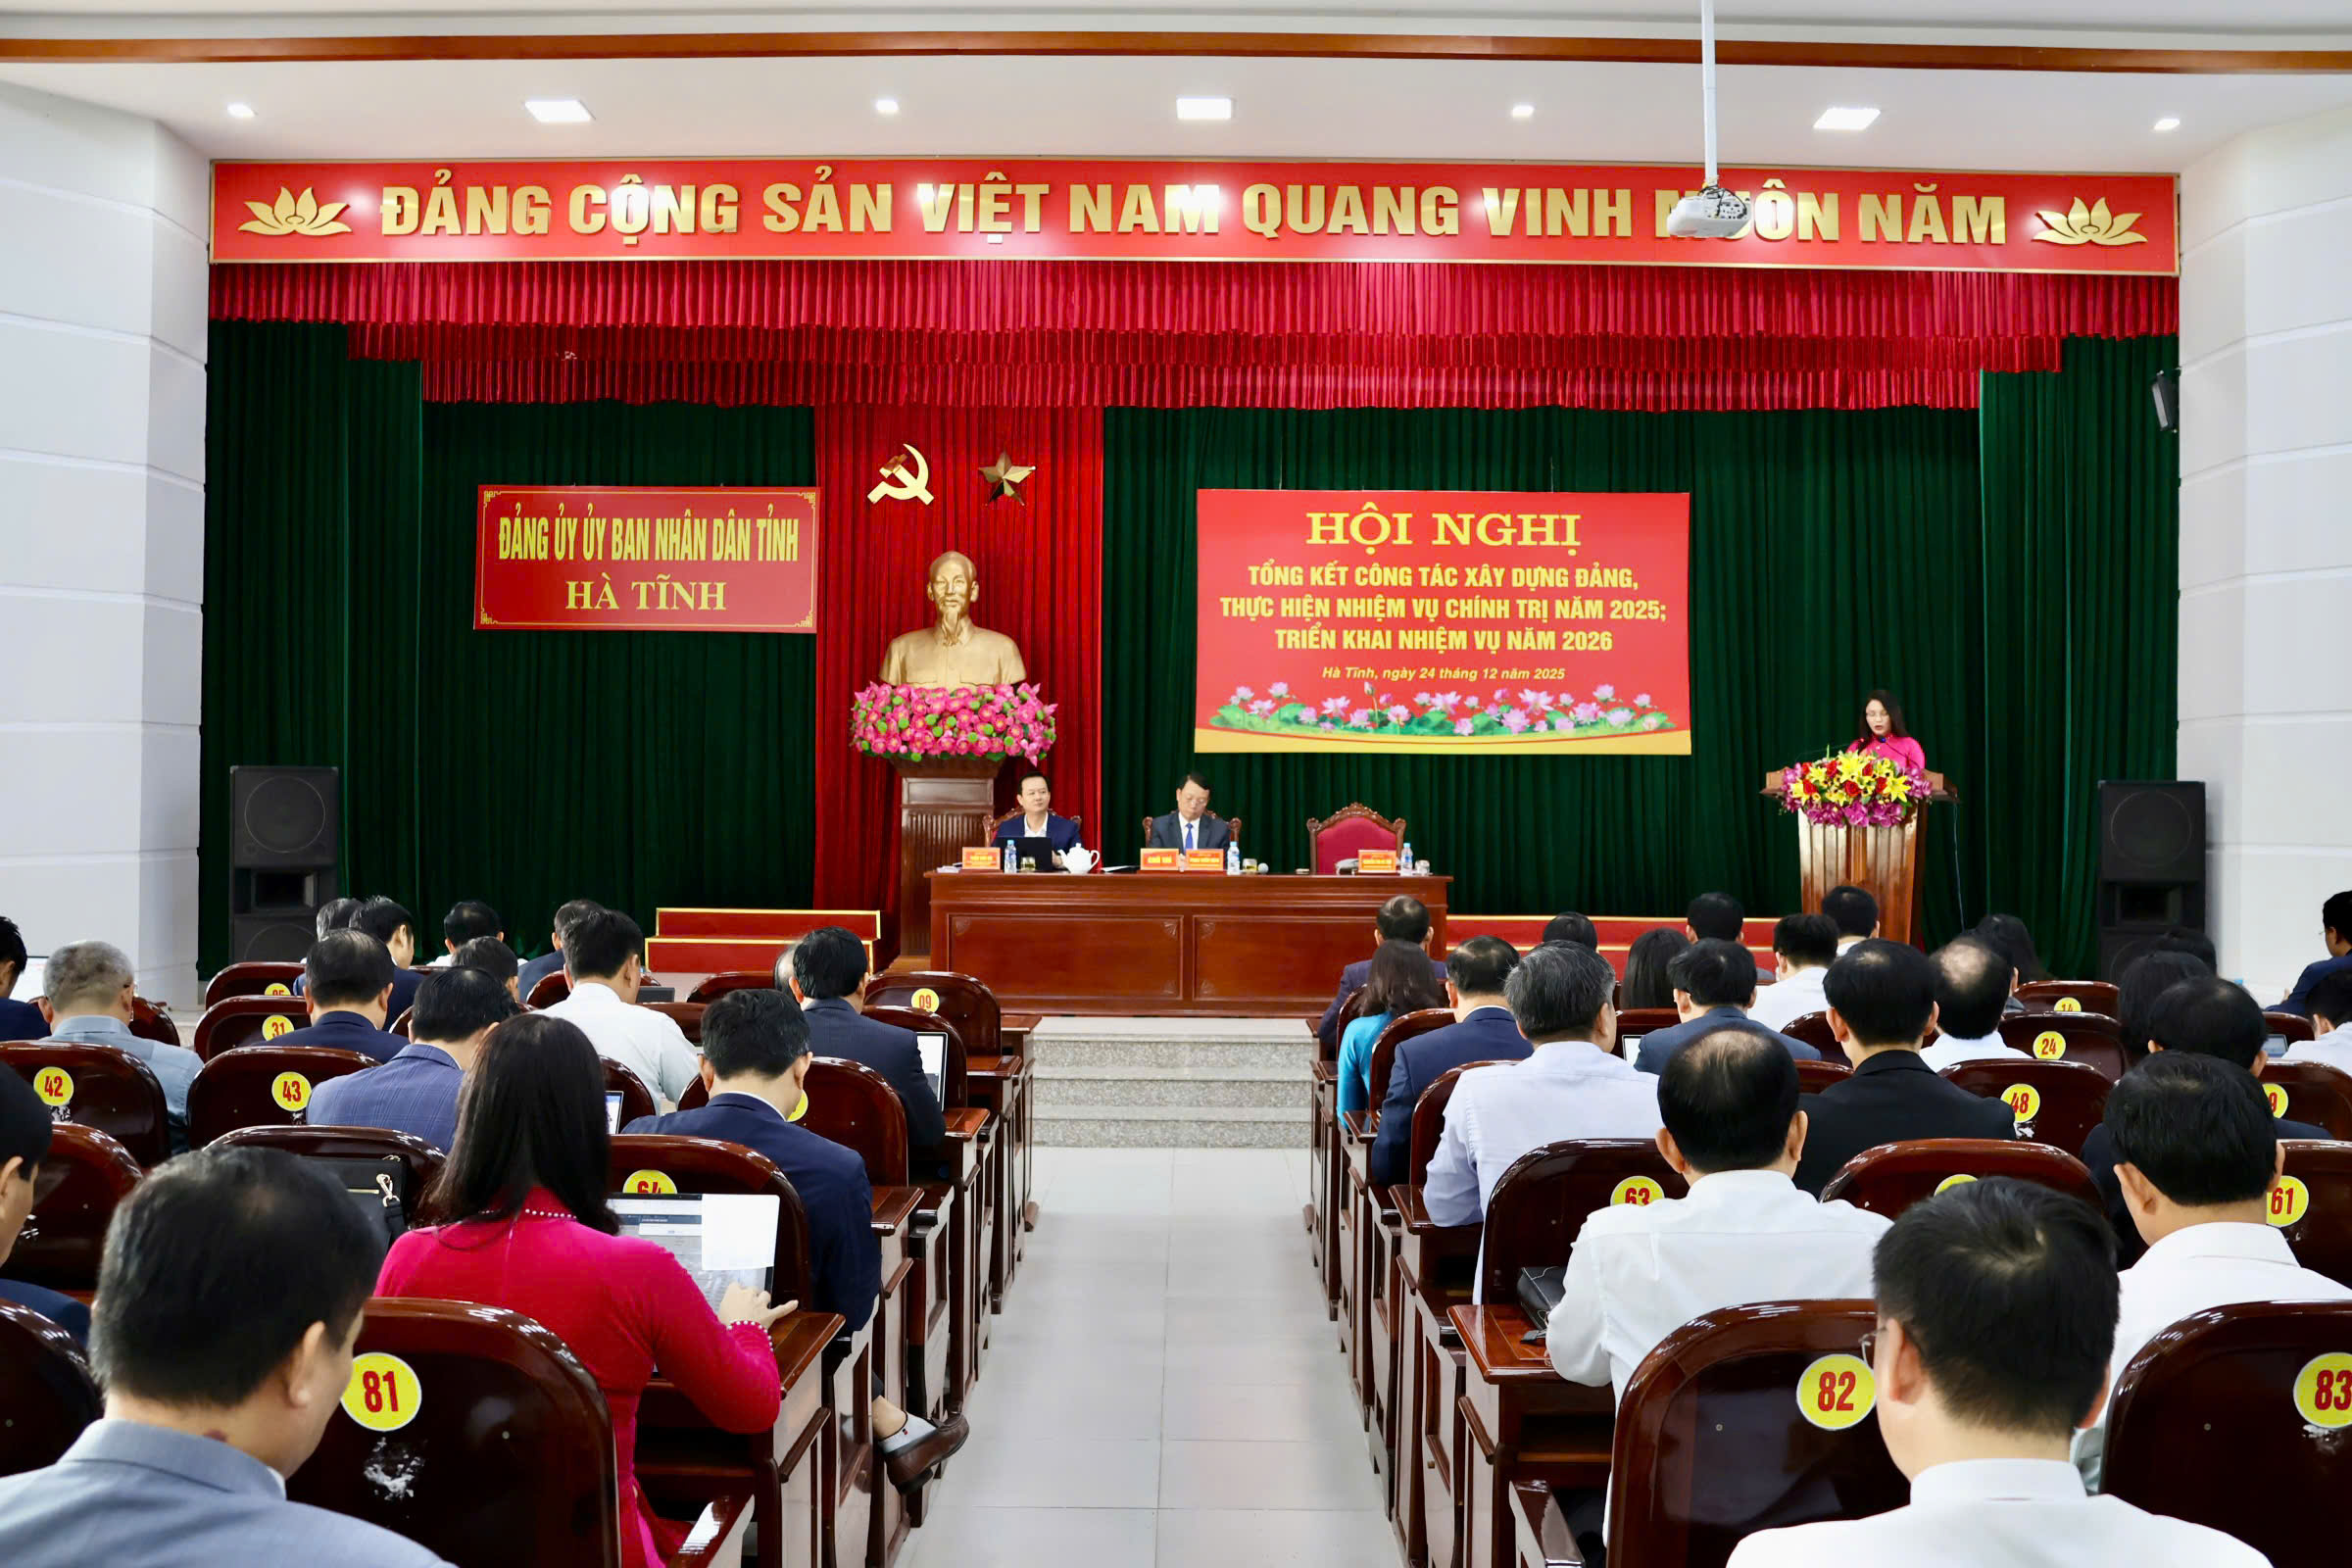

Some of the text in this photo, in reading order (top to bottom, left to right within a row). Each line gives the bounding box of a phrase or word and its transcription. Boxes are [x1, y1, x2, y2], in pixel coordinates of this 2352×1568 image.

[379, 169, 552, 235] ĐẢNG
[568, 173, 738, 245] CỘNG
[762, 166, 893, 233] SẢN
[916, 172, 1050, 244] VIỆT
[1069, 183, 1220, 235] NAM
[1243, 183, 1459, 239] QUANG
[1482, 187, 1633, 238] VINH
[1860, 182, 2006, 245] NĂM
[499, 502, 800, 562] ĐẢNG ỦY ỦY BAN NHÂN DÂN TỈNH
[1306, 501, 1582, 556] HỘI NGHỊ
[1249, 559, 1639, 591] TỔNG KẾT CÔNG TÁC XÂY DỰNG ĐẢNG,
[565, 572, 727, 612] HÀ TĨNH
[1220, 594, 1666, 623] THỰC HIỆN NHIỆM VỤ CHÍNH TRỊ NĂM 2025;
[1275, 621, 1613, 655] TRIỂN KHAI NHIỆM VỤ NĂM 2026
[1323, 666, 1565, 682] Hà Tĩnh, ngày 24 tháng 12 năm 2025
[919, 995, 931, 1009] 09
[271, 1021, 285, 1037] 31
[2041, 1038, 2056, 1054] 24
[44, 1075, 64, 1097] 42
[283, 1081, 302, 1102] 43
[2011, 1092, 2030, 1113] 48
[1625, 1188, 1650, 1205] 63
[2271, 1187, 2295, 1214] 61
[363, 1370, 399, 1412] 81
[1818, 1371, 1856, 1411] 82
[2315, 1369, 2352, 1411] 83
